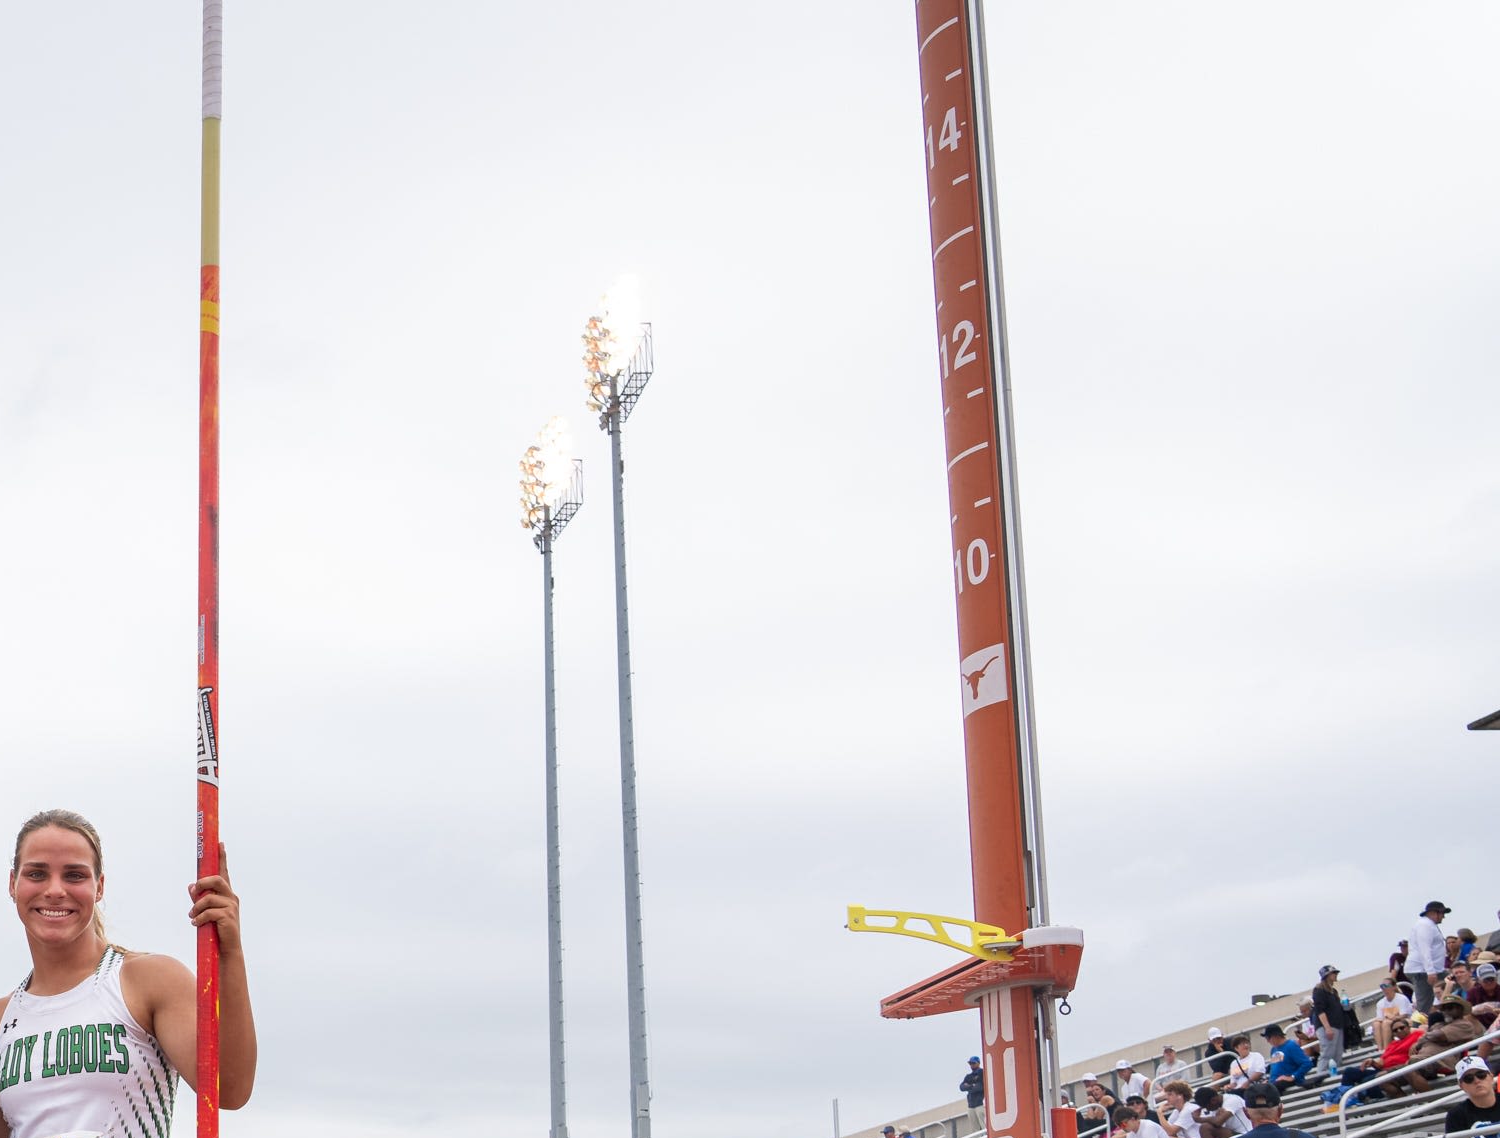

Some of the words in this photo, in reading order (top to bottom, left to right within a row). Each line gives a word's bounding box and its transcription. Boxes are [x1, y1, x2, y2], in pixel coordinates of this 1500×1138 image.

[925, 107, 961, 169] 14
[940, 320, 977, 380] 12
[954, 539, 990, 594] 10
[42, 1023, 130, 1078] LOBOES
